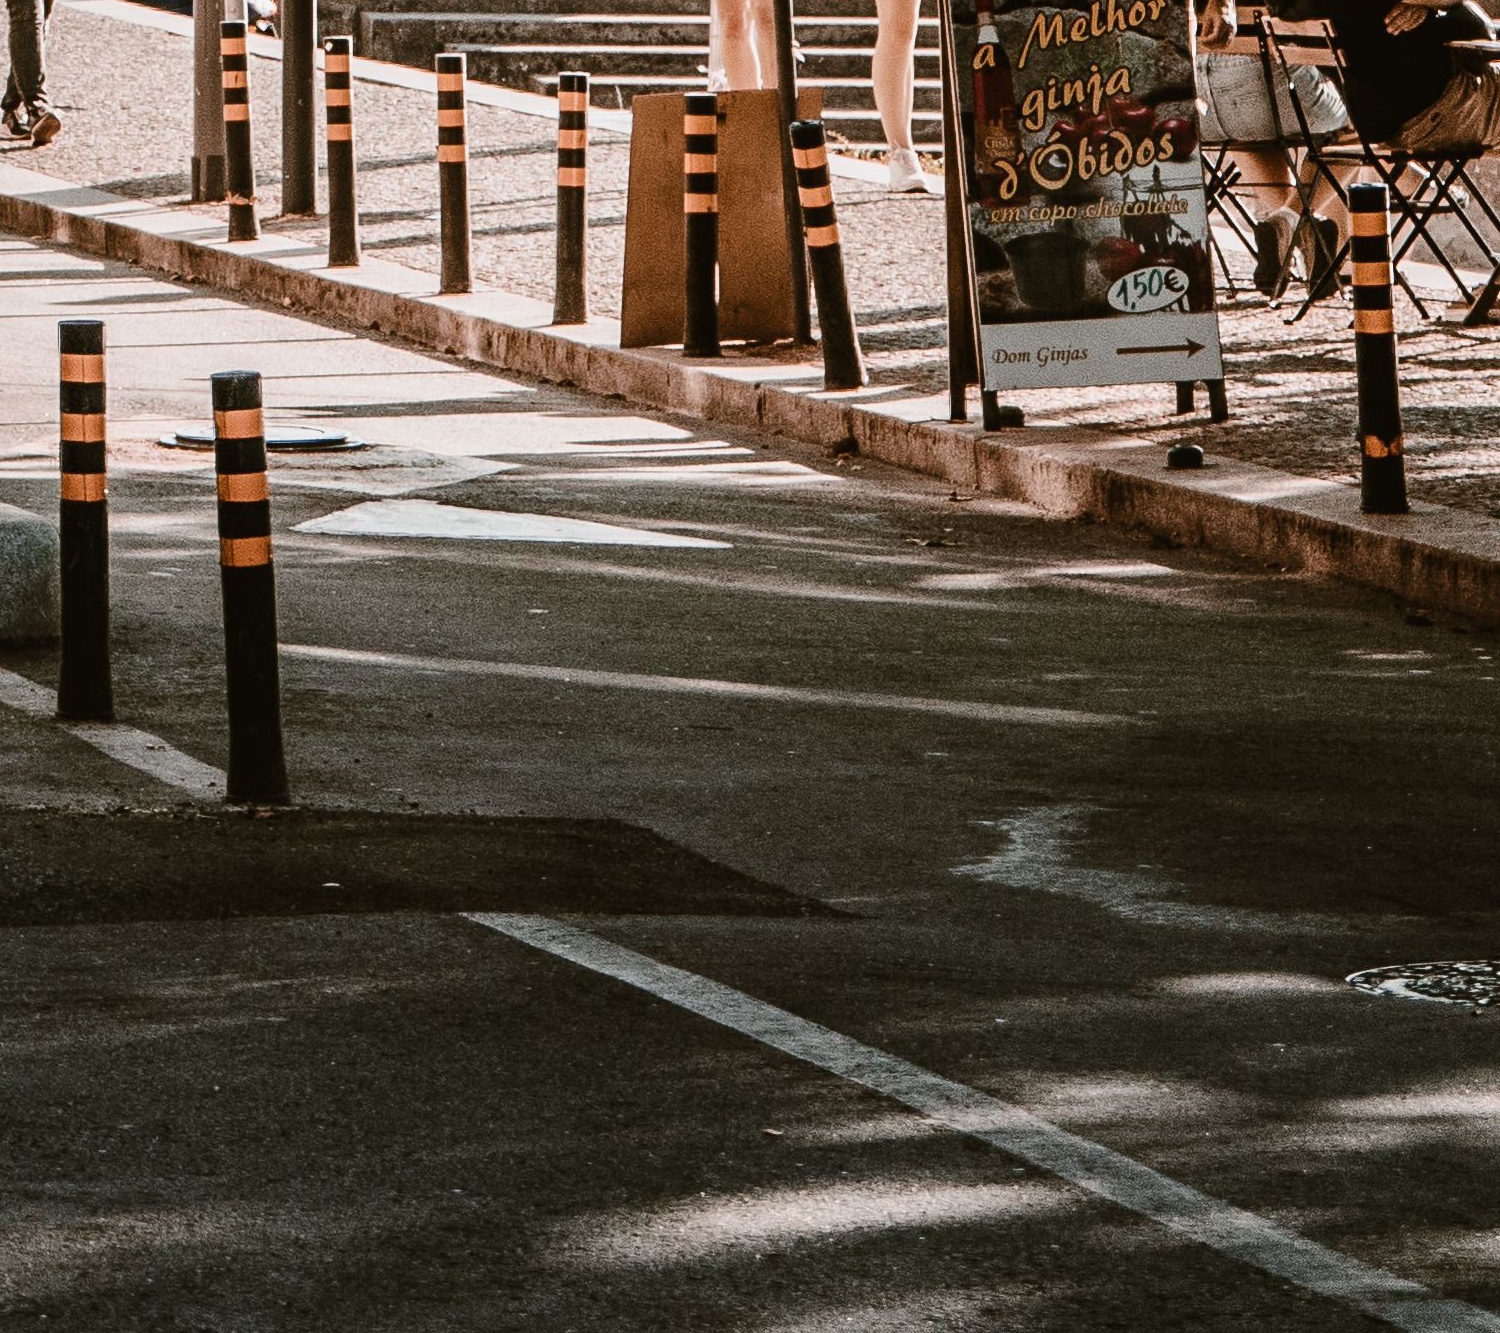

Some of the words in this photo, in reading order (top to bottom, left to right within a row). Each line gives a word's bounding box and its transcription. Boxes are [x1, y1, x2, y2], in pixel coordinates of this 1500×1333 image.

[973, 42, 996, 70] a
[1022, 65, 1131, 132] ginja
[995, 129, 1175, 201] d'Óbidos
[990, 206, 1022, 224] em
[1028, 206, 1078, 227] copo
[1083, 194, 1189, 220] chocolate
[1115, 268, 1186, 311] 1,50€
[992, 347, 1032, 365] Dom
[1036, 345, 1089, 368] Ginjas
